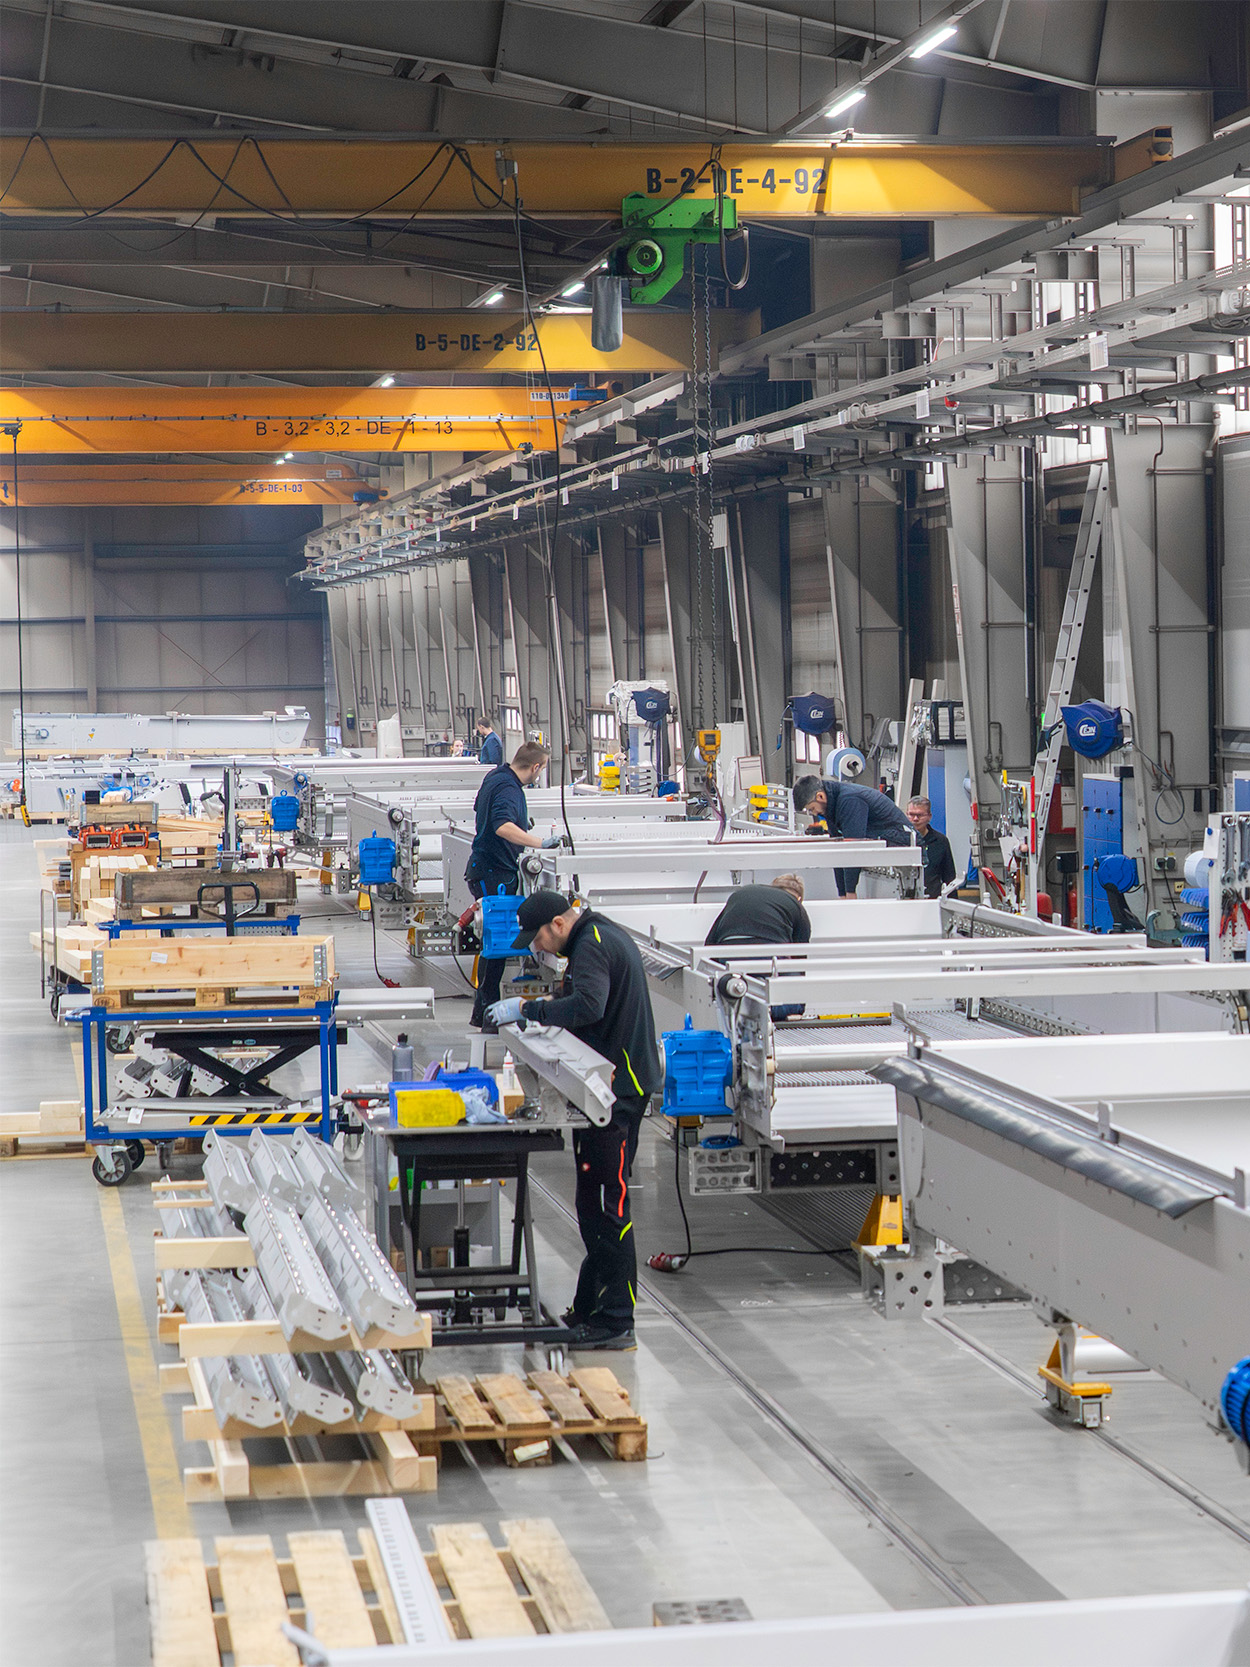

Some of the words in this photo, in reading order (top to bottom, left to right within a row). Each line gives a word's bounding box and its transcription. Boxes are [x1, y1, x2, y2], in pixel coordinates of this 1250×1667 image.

[646, 168, 827, 194] B-2-DE-4-92
[415, 333, 538, 352] B-5-DE-2-92
[256, 422, 267, 436] B
[284, 421, 309, 436] 3,2
[325, 421, 350, 437] 3,2
[367, 421, 392, 435] DE
[435, 421, 453, 434] 13
